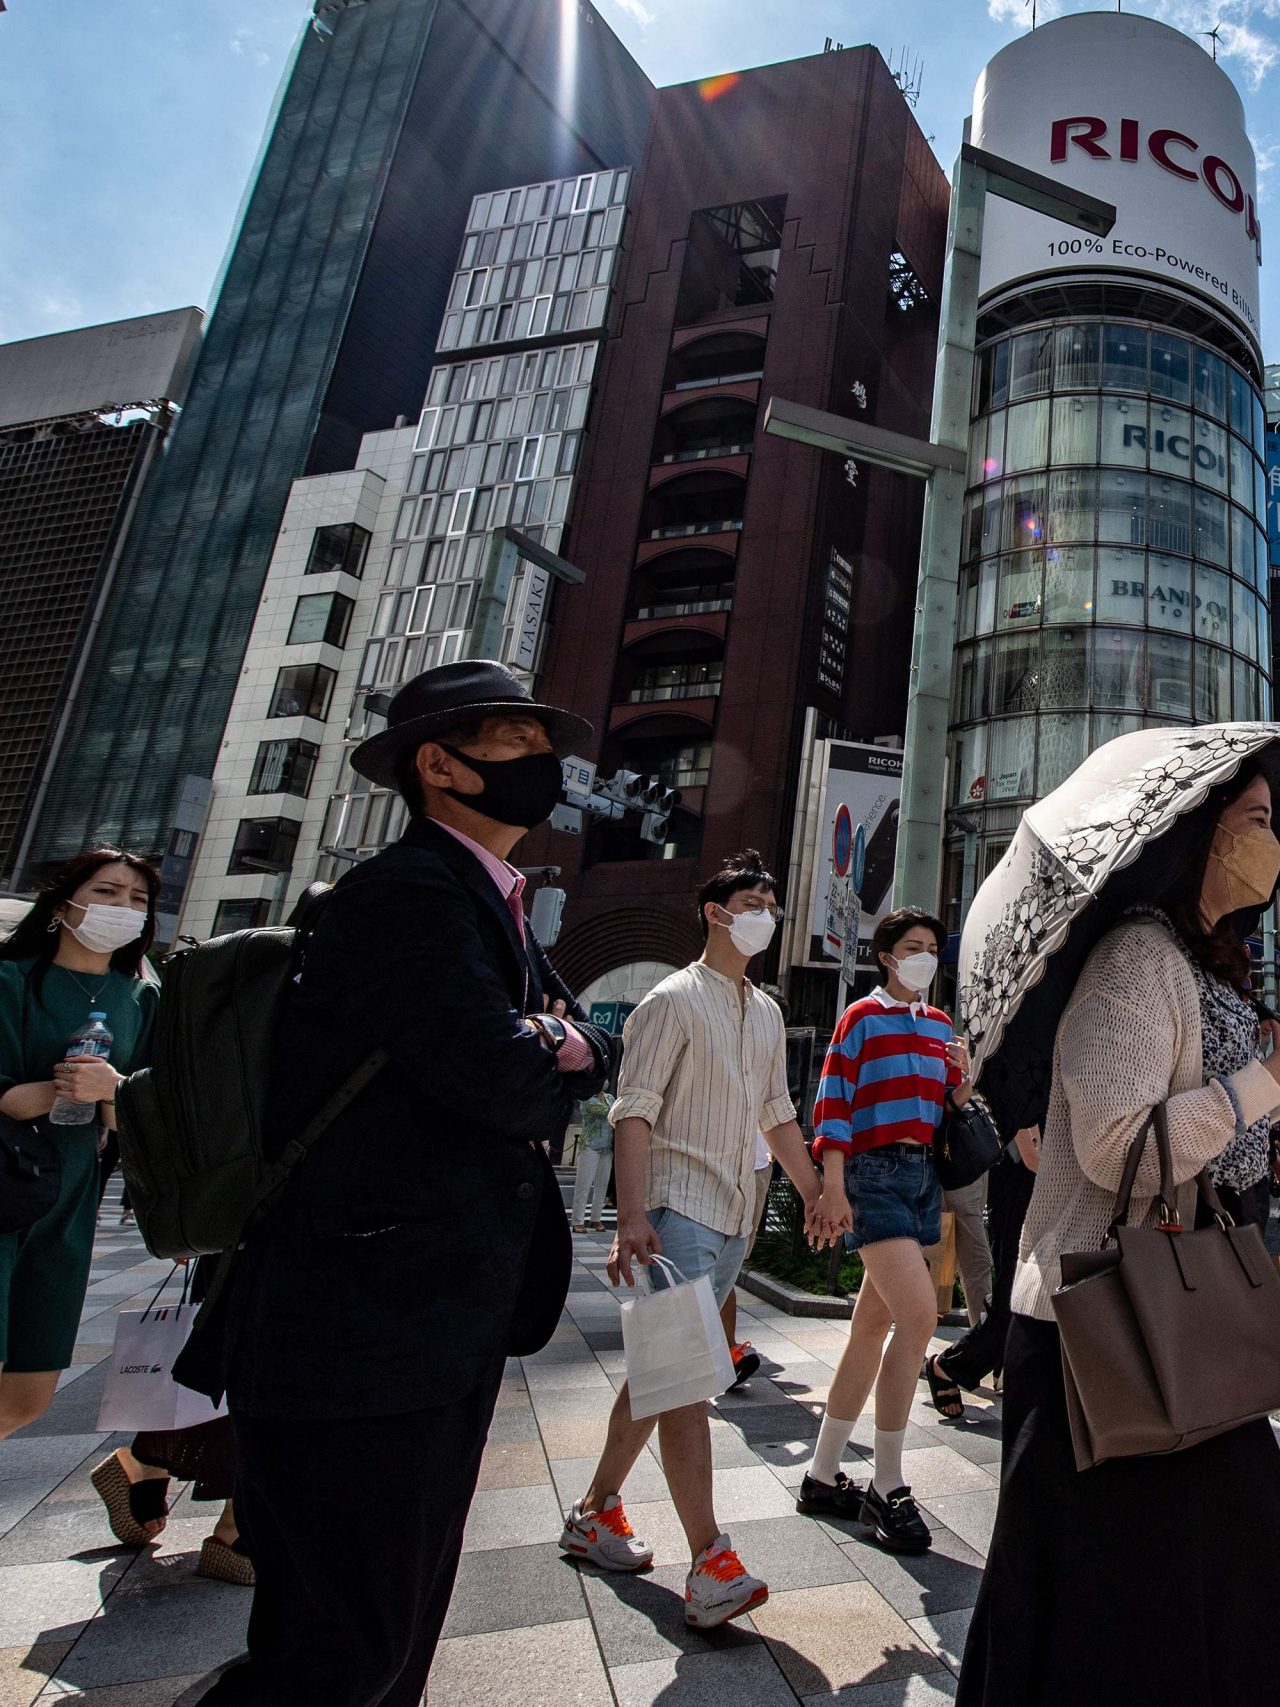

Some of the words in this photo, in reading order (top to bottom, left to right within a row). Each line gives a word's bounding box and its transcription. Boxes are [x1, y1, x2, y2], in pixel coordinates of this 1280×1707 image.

[1047, 238, 1103, 257] 100%
[1112, 239, 1228, 296] Eco-Powered
[844, 380, 867, 487] 鳩堂
[1123, 423, 1236, 486] RICOH
[520, 574, 545, 655] TASAKI
[1111, 580, 1202, 609] BRAND
[1160, 605, 1220, 630] TOYO
[120, 1365, 149, 1374] LACOSTE
